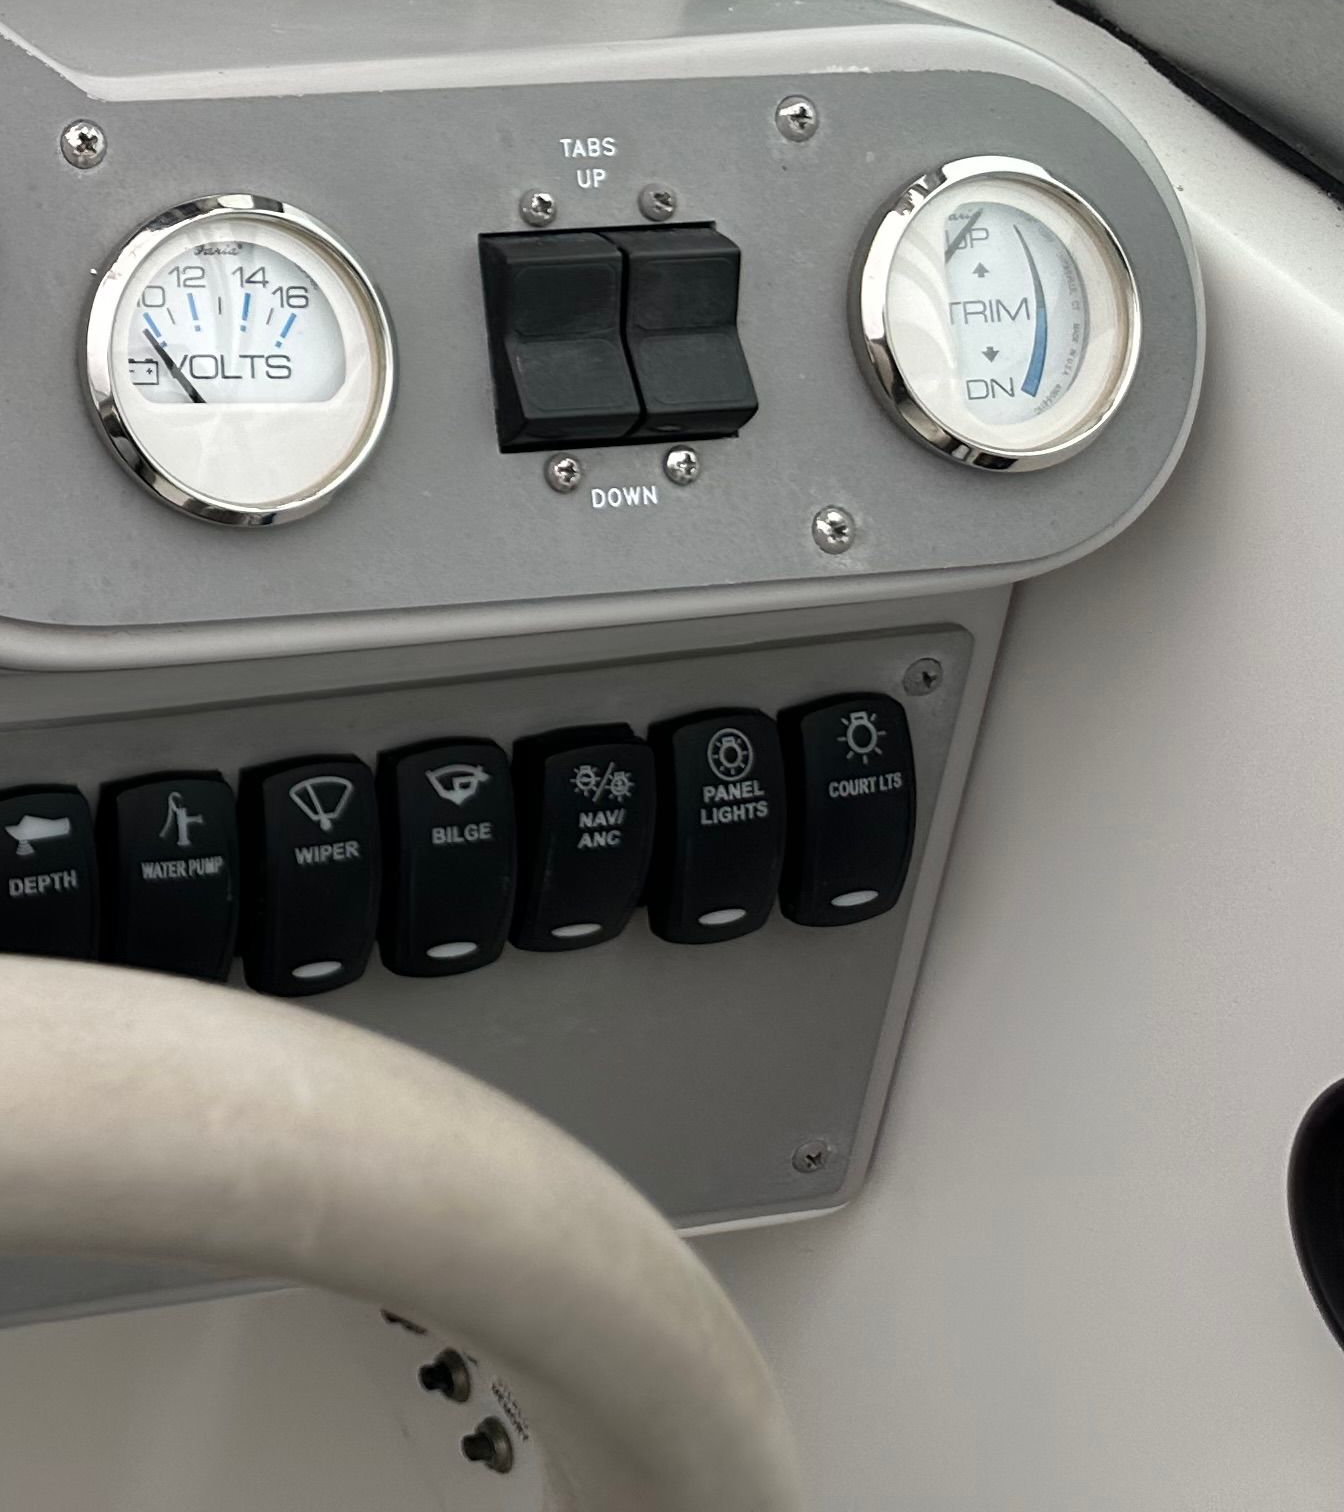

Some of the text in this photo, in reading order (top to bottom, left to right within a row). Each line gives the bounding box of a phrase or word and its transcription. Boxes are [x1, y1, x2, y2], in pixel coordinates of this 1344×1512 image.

[560, 137, 617, 158] TABS
[577, 169, 606, 188] UP
[168, 265, 206, 288] 12
[231, 266, 268, 288] 14
[137, 285, 165, 307] 0
[271, 286, 309, 309] 16
[949, 297, 1030, 324] TRIM
[172, 354, 292, 379] VOLTS
[966, 378, 1014, 400] DN
[591, 486, 658, 509] DOWN
[703, 780, 764, 803] PANEL
[829, 772, 902, 799] COURT LTS
[700, 801, 769, 825] LIGHTS
[432, 822, 493, 845] BILGE
[578, 829, 621, 849] ANC
[295, 840, 360, 865] WIPER
[142, 856, 223, 880] WATER PUMP
[9, 870, 77, 896] DEPTH
